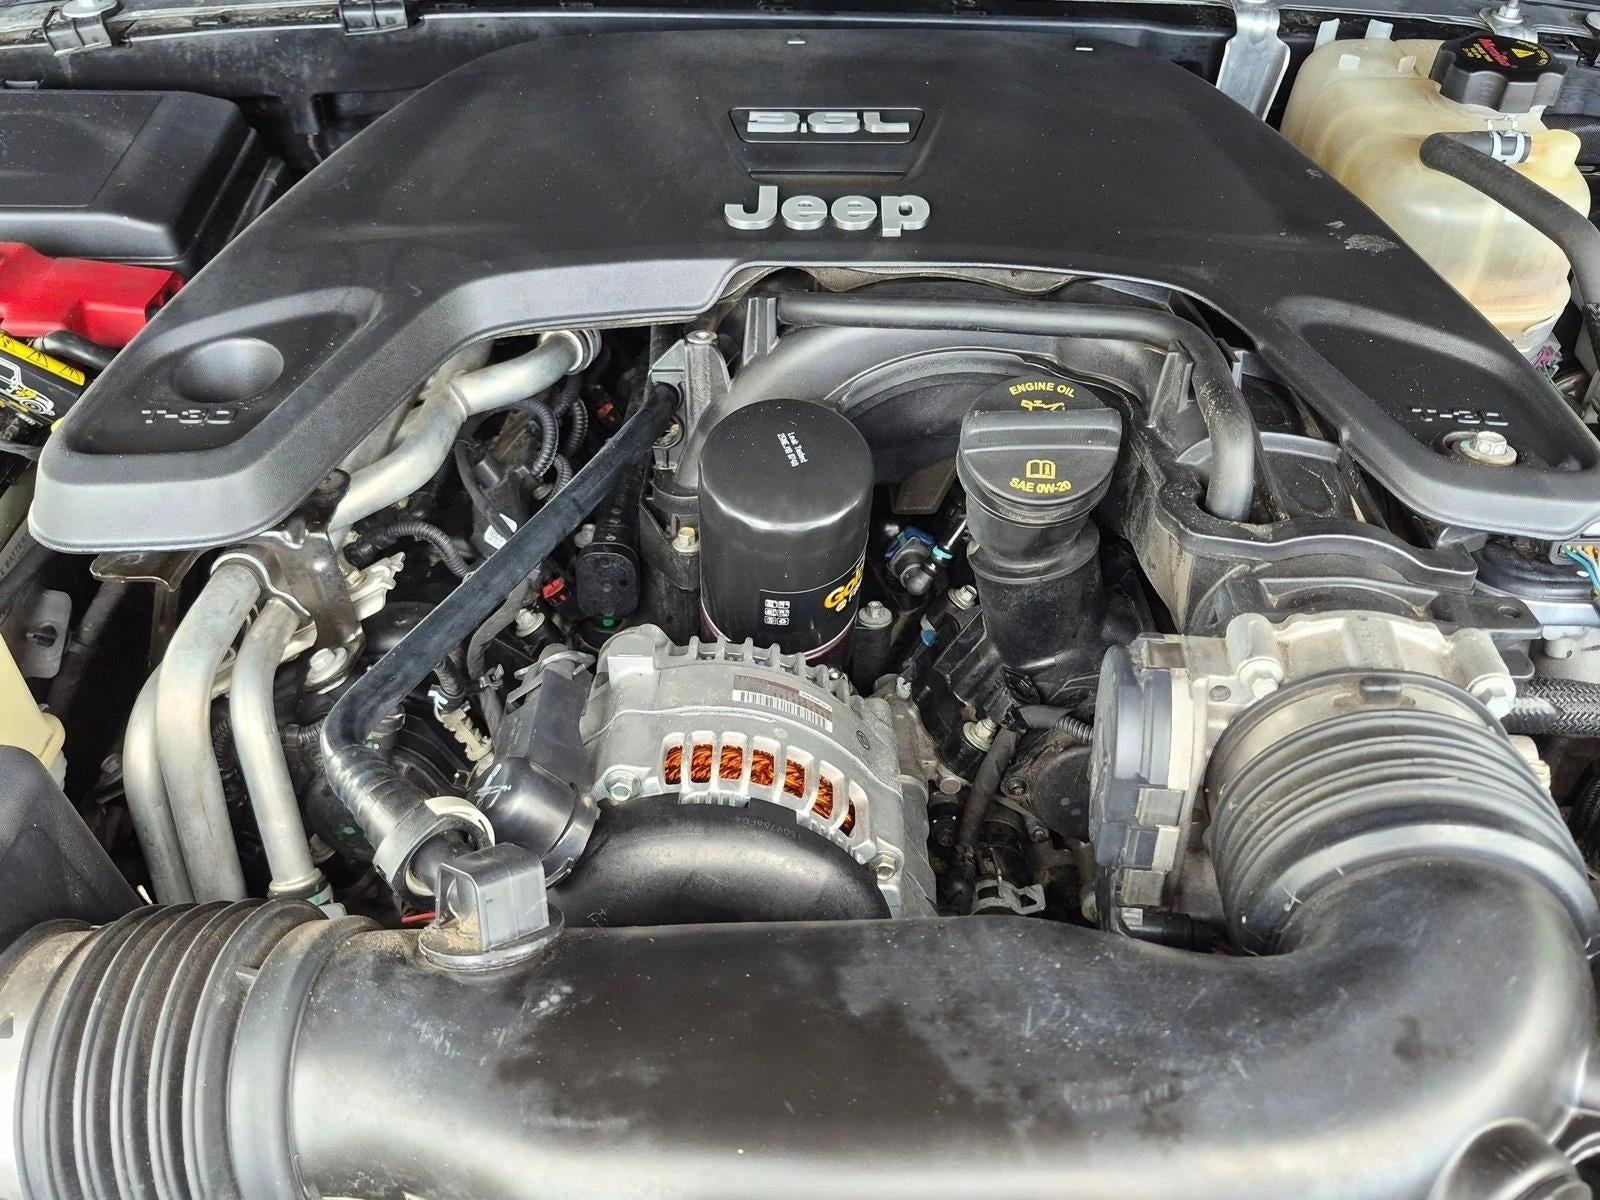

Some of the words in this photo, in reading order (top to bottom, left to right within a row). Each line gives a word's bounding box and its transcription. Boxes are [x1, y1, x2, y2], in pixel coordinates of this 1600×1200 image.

[747, 111, 910, 133] 3.6L
[724, 185, 930, 237] Jeep
[1009, 382, 1054, 395] ENGINE
[1057, 384, 1075, 397] OIL
[1009, 477, 1034, 493] SAE
[1037, 480, 1071, 493] 0W-20
